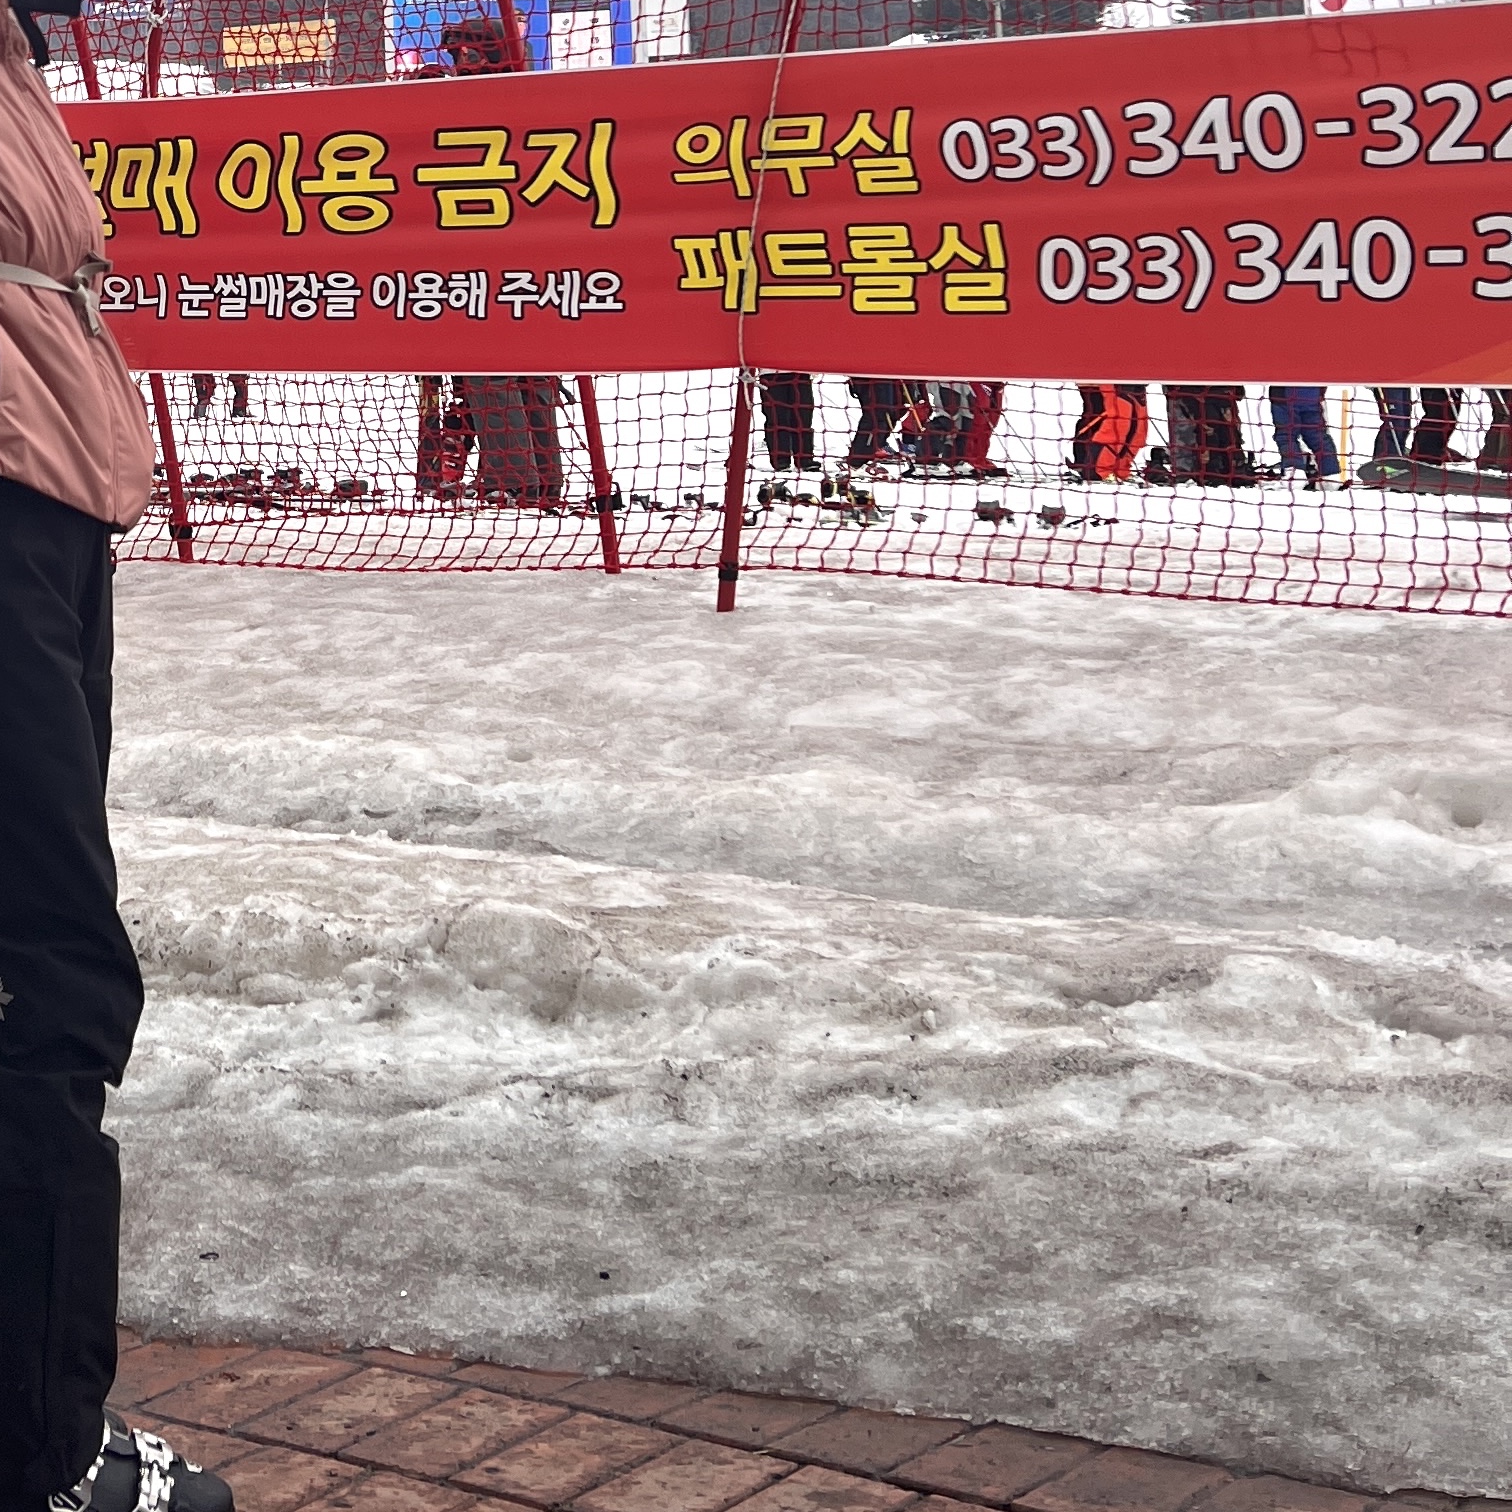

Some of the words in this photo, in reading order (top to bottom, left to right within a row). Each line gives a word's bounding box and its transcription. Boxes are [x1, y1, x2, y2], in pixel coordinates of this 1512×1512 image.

[218, 133, 394, 233] 이용
[417, 121, 617, 227] 금지
[674, 108, 919, 197] 의무실
[178, 272, 361, 318] 눈썰매장을
[372, 271, 487, 318] 이용해
[497, 270, 624, 318] 주세요
[674, 223, 1008, 312] 패트롤실
